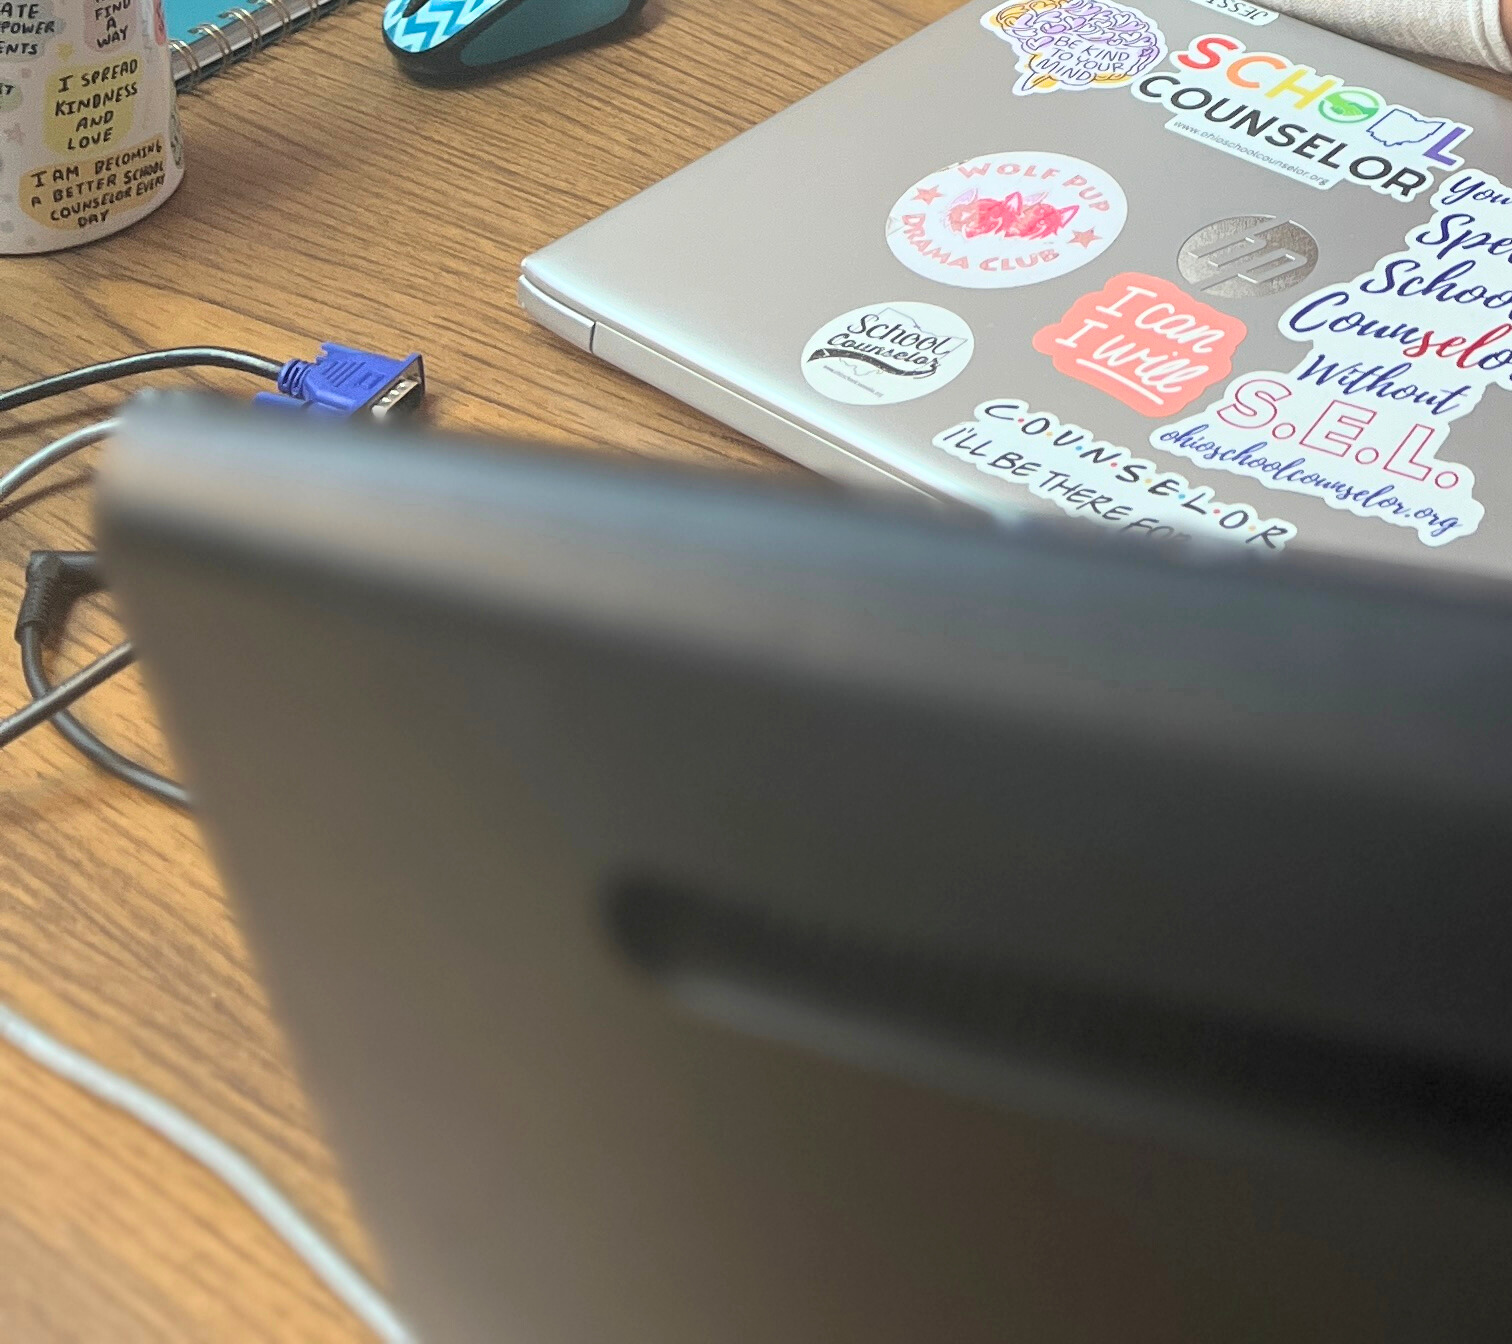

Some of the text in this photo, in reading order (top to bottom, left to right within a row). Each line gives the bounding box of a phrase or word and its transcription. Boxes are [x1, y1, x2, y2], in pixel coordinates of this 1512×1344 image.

[97, 25, 129, 49] WAY
[106, 15, 117, 31] A
[1035, 58, 1092, 81] MIND
[1051, 47, 1124, 73] TO YOUR
[1054, 35, 1130, 63] BE KIND
[55, 82, 138, 116] KINDNESS
[58, 58, 138, 93] I SPREAD
[68, 127, 114, 151] LOVE
[76, 110, 114, 132] AND
[1139, 75, 1426, 196] COUNSELOR
[31, 139, 163, 188] I AM BECOMING
[1173, 120, 1330, 187] www.ohioschoolcounselor.org
[31, 161, 164, 208] A BETTER SCHOOL
[51, 173, 165, 221] COUNSELOR EVERY
[957, 162, 1110, 212] WOLF PUP
[77, 210, 110, 228] DAY
[902, 213, 1060, 271] DRAMA CLUB
[847, 314, 951, 355] School
[1096, 285, 1225, 354] I can
[827, 333, 941, 368] Counselor
[1055, 319, 1209, 393] I will
[1297, 354, 1472, 415] Without
[1217, 379, 1459, 489] S.E.L.
[942, 427, 994, 457] I'LL
[988, 451, 1041, 477] BE
[1039, 471, 1134, 523] THERE
[1160, 424, 1461, 537] ohioschoolcounselor.org
